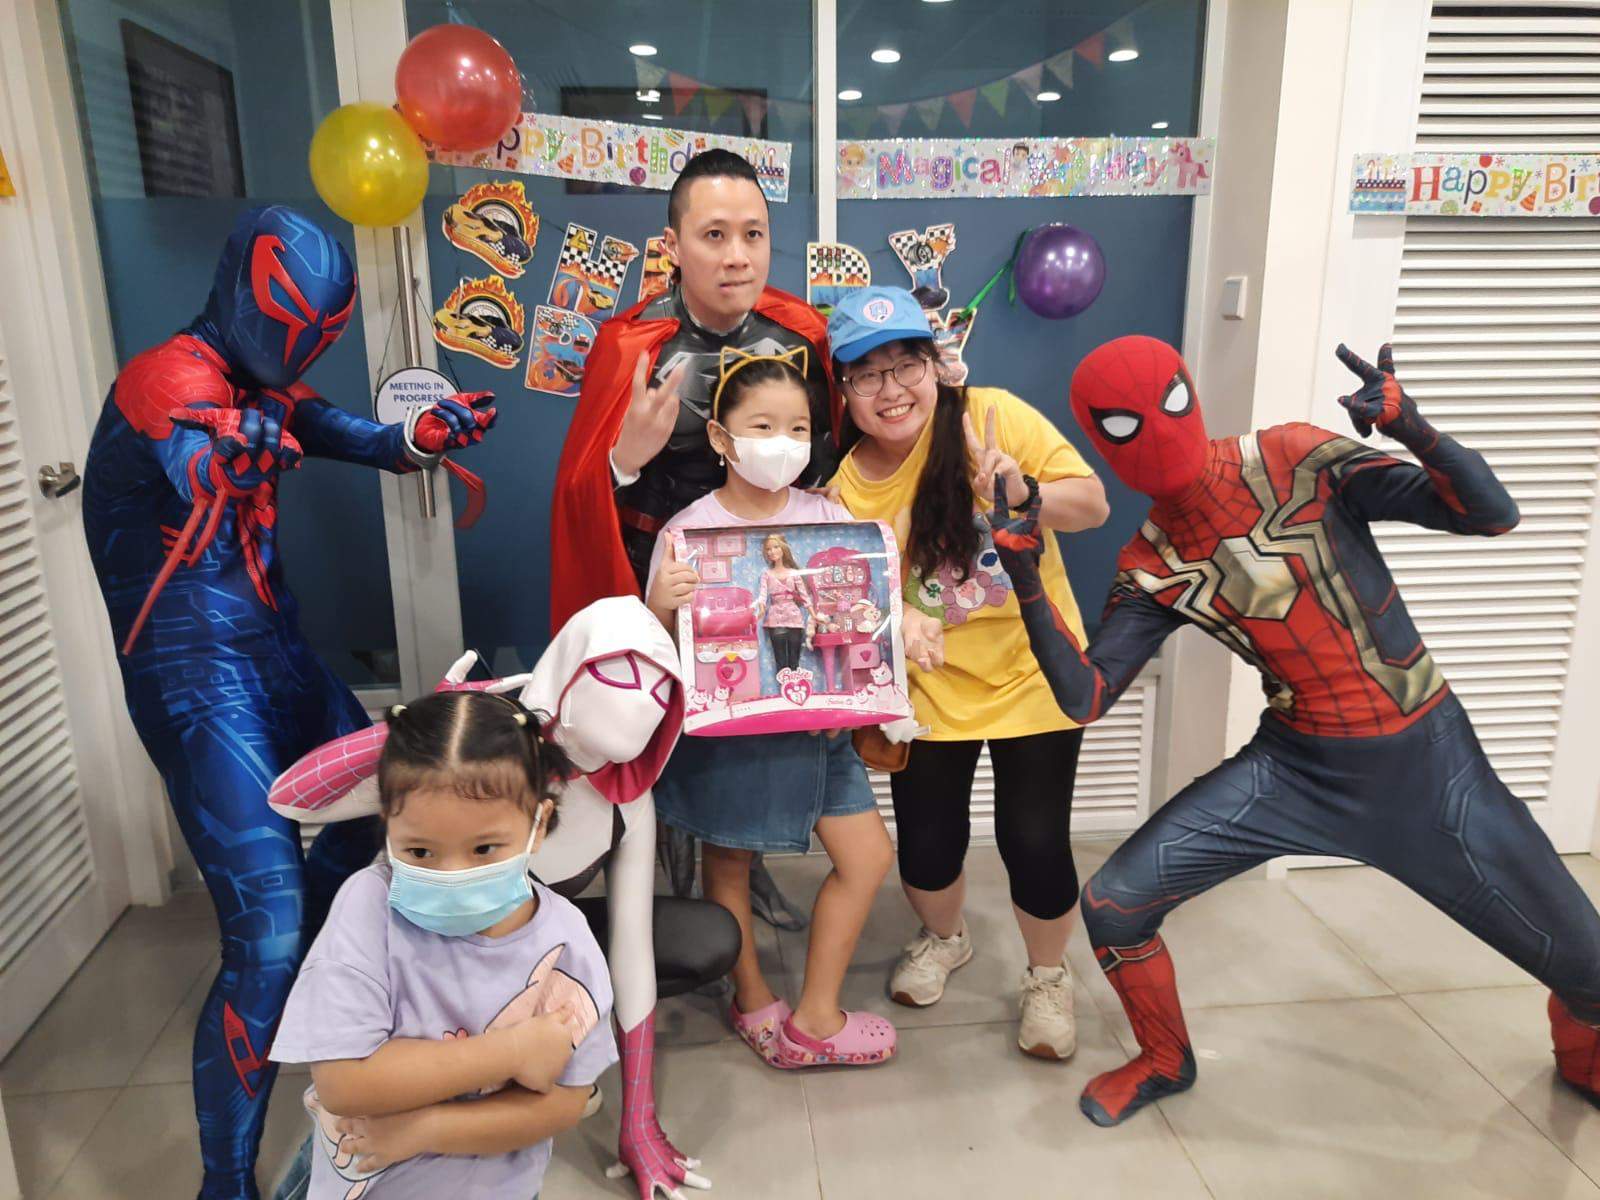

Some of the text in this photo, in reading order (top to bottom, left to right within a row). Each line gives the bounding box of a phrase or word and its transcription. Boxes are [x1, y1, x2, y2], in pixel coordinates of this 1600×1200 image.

[496, 126, 694, 175] ppy Birthd
[876, 148, 1013, 191] Magical
[1410, 163, 1600, 204] Happy Bir
[389, 382, 445, 391] MEETING IN
